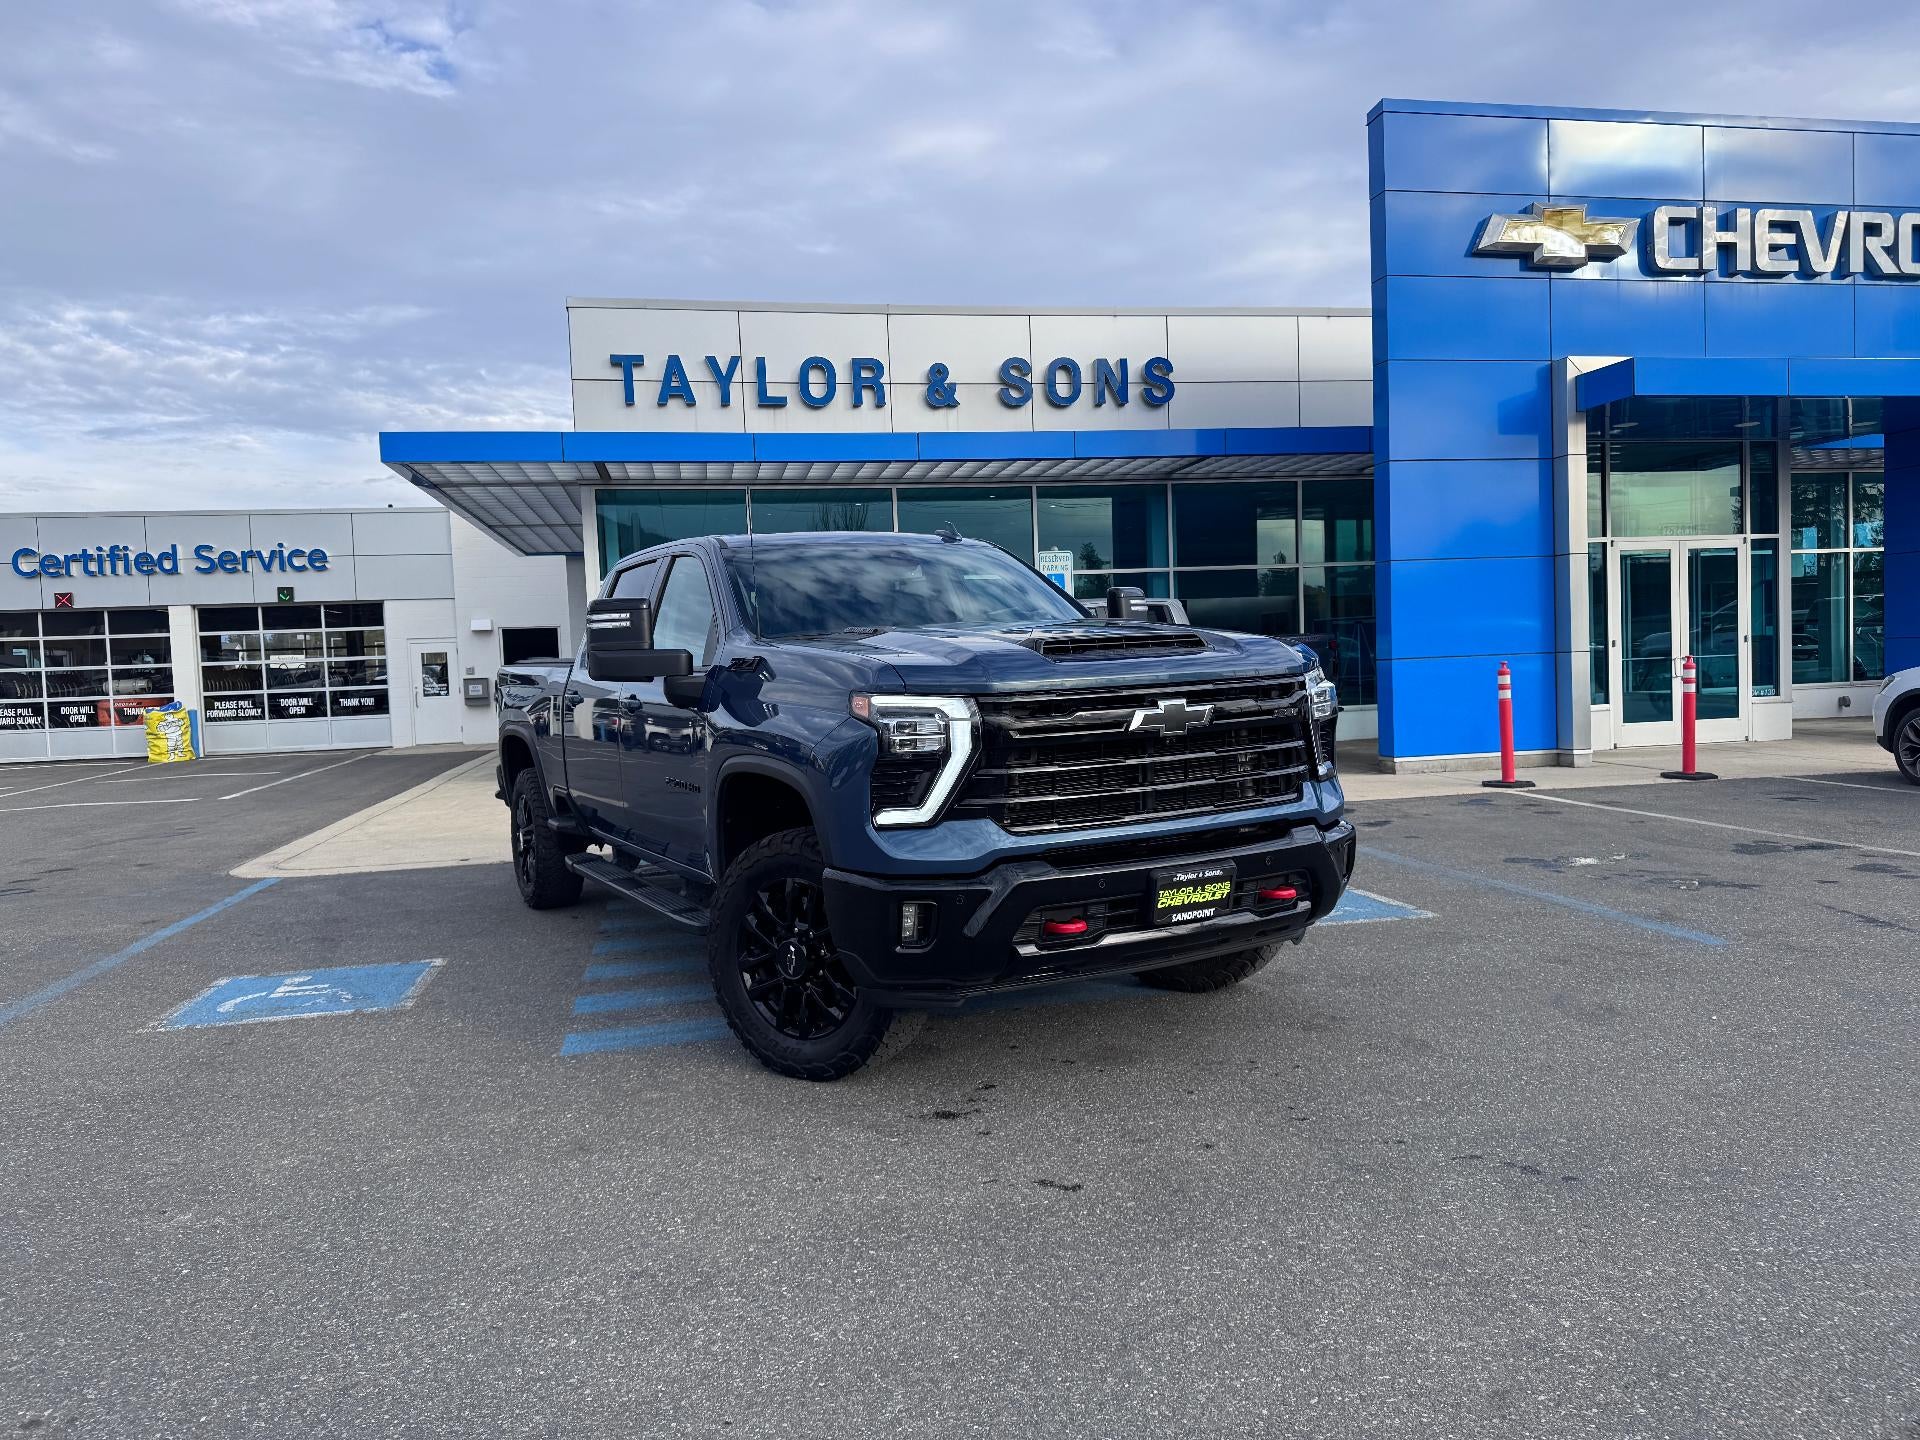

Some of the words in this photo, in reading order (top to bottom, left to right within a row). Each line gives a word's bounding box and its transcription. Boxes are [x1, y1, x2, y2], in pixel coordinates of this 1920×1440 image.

[609, 353, 886, 408] TAYLOR
[925, 361, 960, 408] &
[999, 356, 1176, 408] SONS
[11, 543, 183, 579] Certified
[194, 542, 330, 574] Service
[1040, 555, 1070, 563] RESERVED
[214, 701, 238, 709] PLEASE
[280, 698, 298, 707] DOOR
[298, 697, 314, 706] WILL
[339, 698, 360, 707] THANK
[360, 697, 375, 706] YOU!
[17, 708, 34, 716] PULL
[61, 707, 79, 715] DOOR
[79, 706, 96, 714] WILL
[124, 707, 145, 716] THANK
[206, 709, 237, 718] FORWARD
[238, 708, 262, 717] SLOWLY
[289, 706, 306, 715] OPEN
[17, 716, 42, 725] SLOWLY
[70, 714, 87, 723] OPEN
[1176, 873, 1198, 881] Taylor
[1159, 887, 1194, 898] TAYLOR
[1196, 886, 1202, 894] &
[1205, 881, 1231, 891] SONS
[1157, 890, 1230, 908] CHEVROLET
[1171, 908, 1216, 922] SANDPOINT
